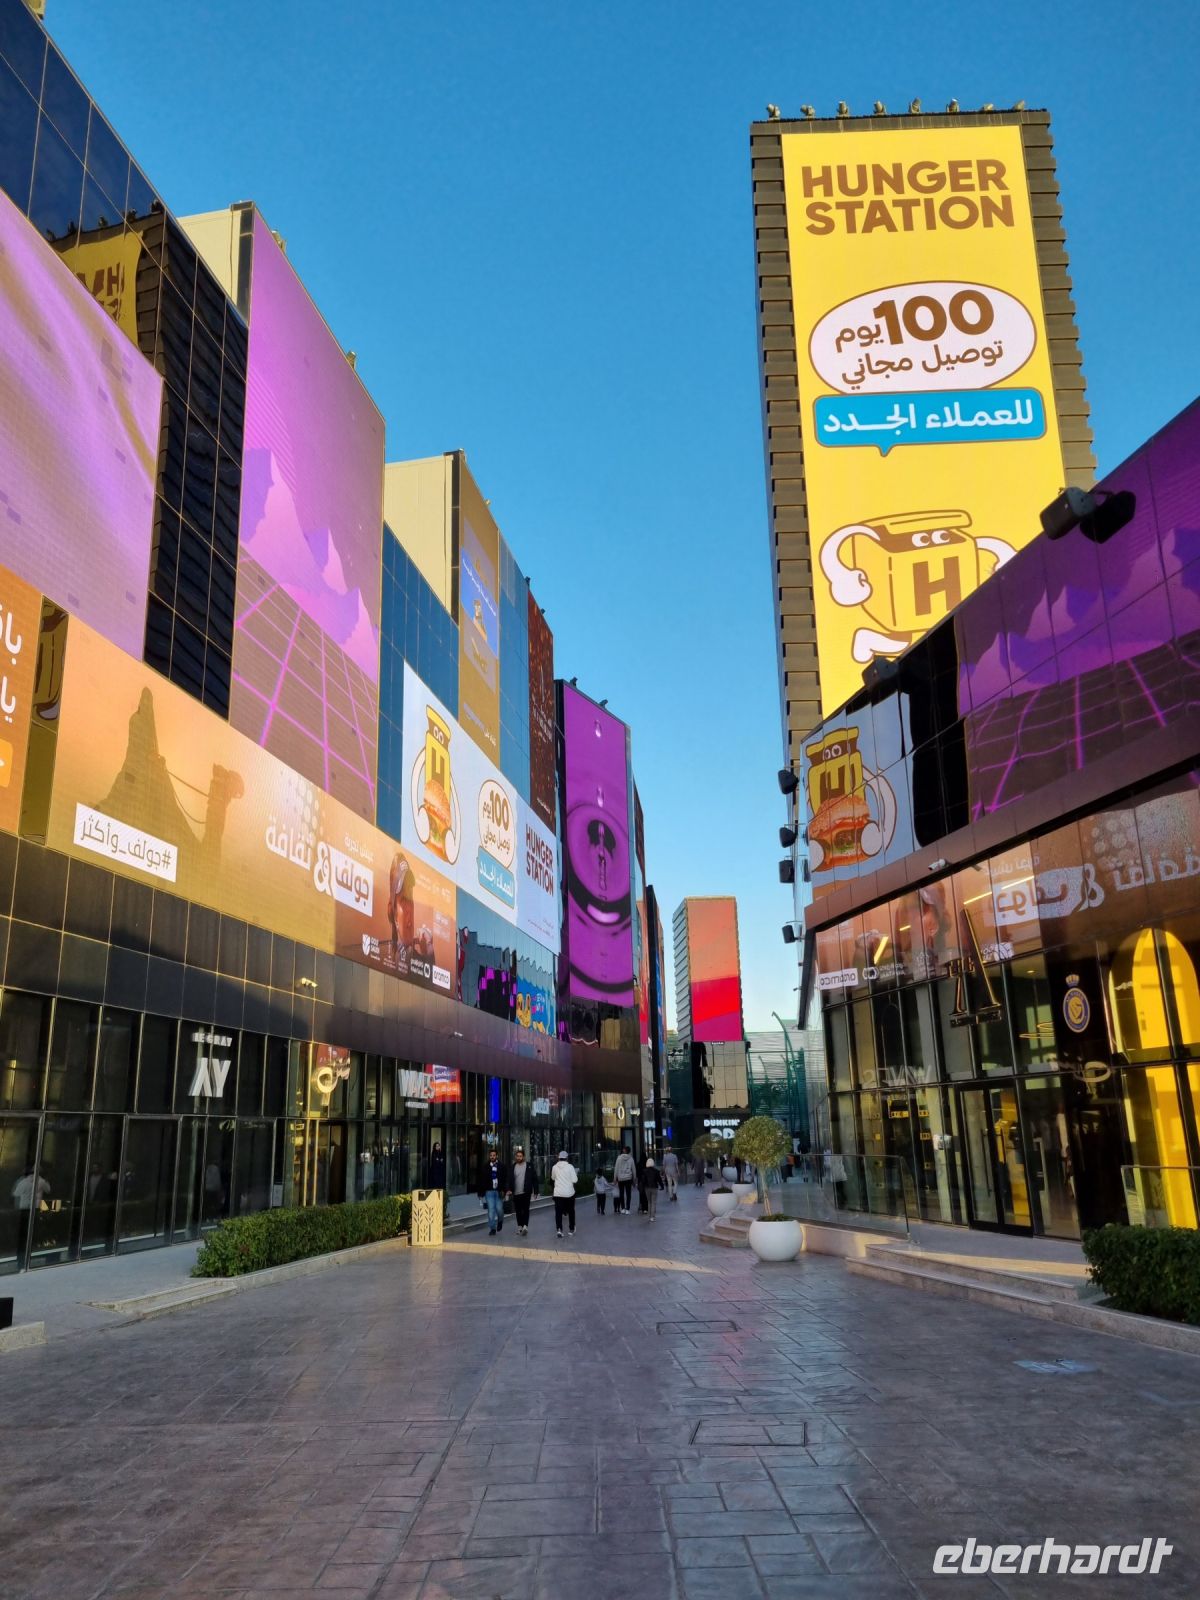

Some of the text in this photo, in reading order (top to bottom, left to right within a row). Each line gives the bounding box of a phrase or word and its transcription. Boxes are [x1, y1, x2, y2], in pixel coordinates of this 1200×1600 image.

[801, 159, 1009, 198] HUNGER
[805, 195, 1015, 235] STATION
[873, 289, 994, 345] 100
[841, 339, 1004, 390] توصيل مجاني
[925, 399, 1034, 430] للعملاء
[526, 823, 553, 870] HUNGER
[335, 861, 370, 908] جولف
[526, 851, 554, 897] STATION
